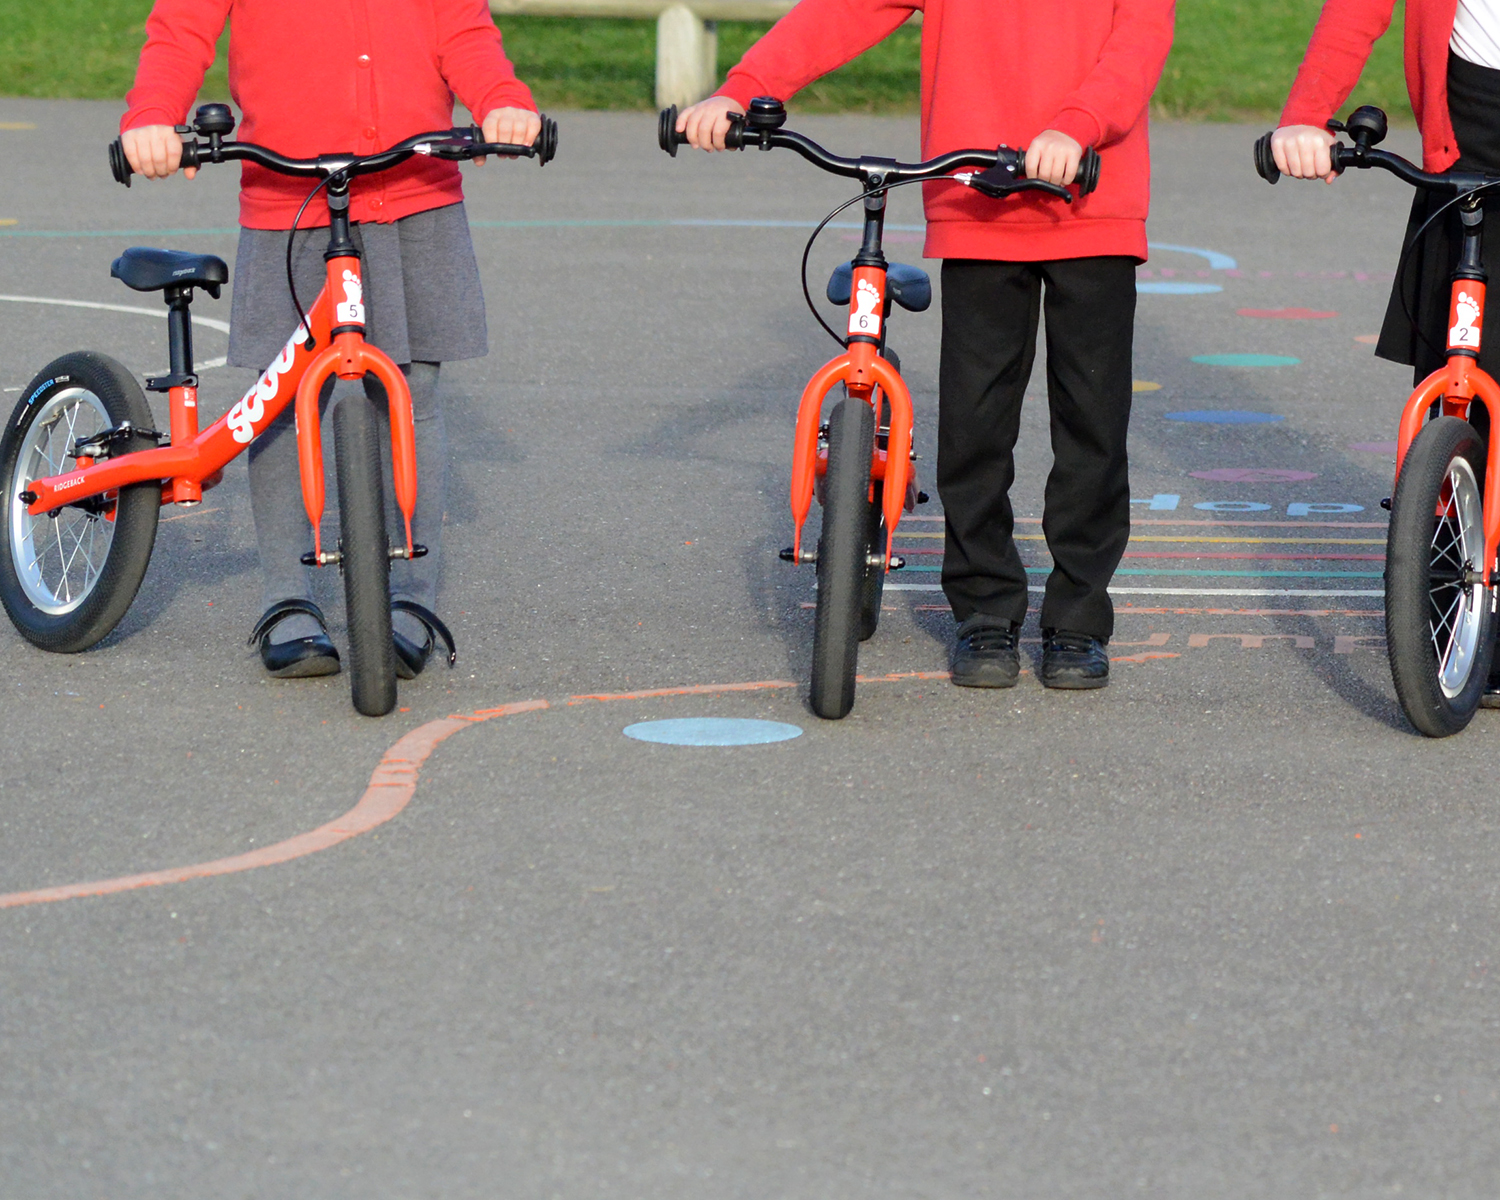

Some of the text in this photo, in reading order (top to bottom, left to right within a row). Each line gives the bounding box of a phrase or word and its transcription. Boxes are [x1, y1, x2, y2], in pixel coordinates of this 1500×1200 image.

[349, 304, 358, 318] 5
[858, 314, 869, 329] 6
[1459, 327, 1469, 342] 2
[53, 476, 86, 492] RIDGEBACK
[1108, 633, 1390, 653] ump
